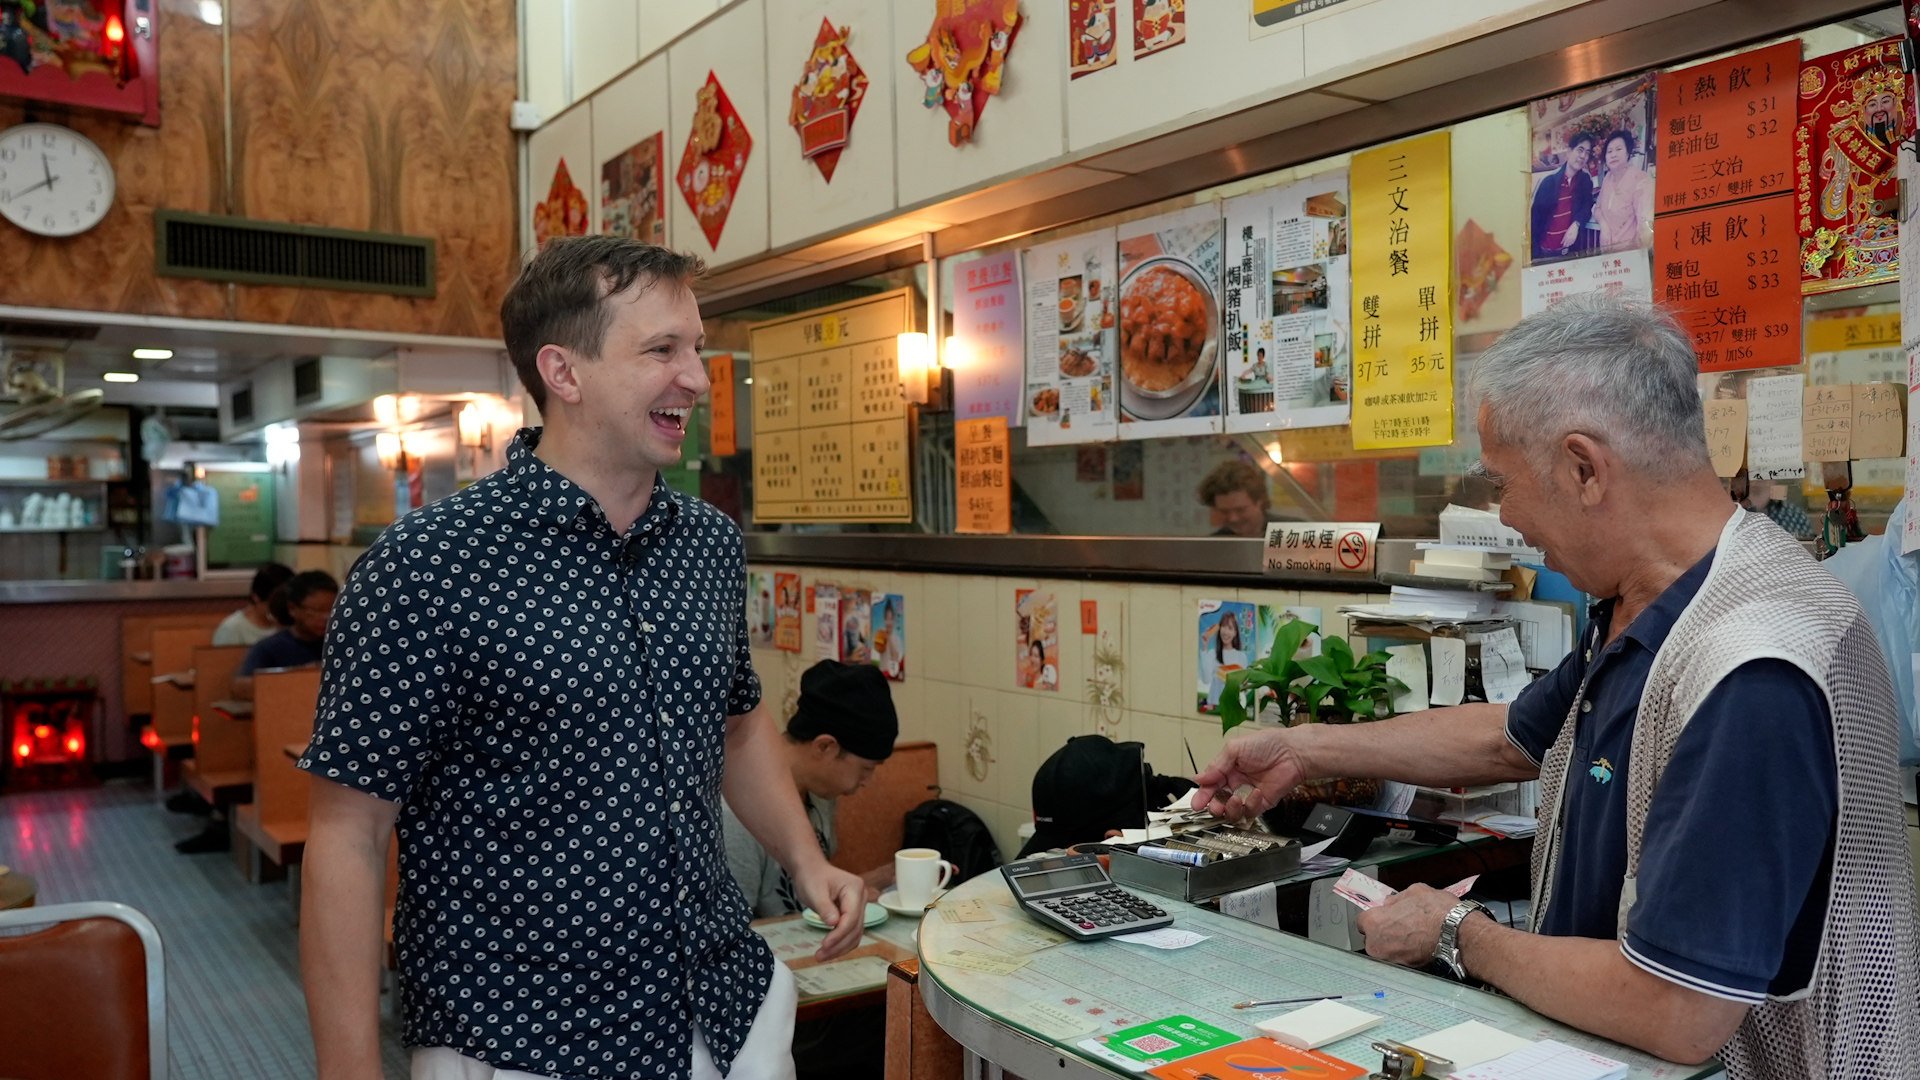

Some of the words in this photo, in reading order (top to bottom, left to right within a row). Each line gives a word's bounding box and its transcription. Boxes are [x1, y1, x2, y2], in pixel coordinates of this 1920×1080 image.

[1747, 96, 1776, 117] $31
[1747, 119, 1778, 139] $32
[21, 134, 32, 150] 11
[42, 133, 56, 150] 12
[1668, 131, 1719, 159] 鮮油包
[1691, 155, 1743, 182] 三文治
[1663, 190, 1687, 207] 單拼
[1727, 179, 1753, 196] 雙拼
[1760, 173, 1784, 189] $37
[1388, 155, 1409, 277] 三文治餐
[1241, 225, 1253, 289] 樓上雅座
[1747, 250, 1779, 267] $32
[1665, 279, 1720, 303] 鮮油包
[1747, 273, 1780, 291] $33
[1227, 266, 1241, 353] 焗豬扒飯
[1418, 285, 1439, 342] 單拼
[1692, 306, 1747, 329] 三文治
[1363, 294, 1381, 349] 雙拼
[1731, 326, 1758, 343] 雙拼
[1764, 323, 1789, 338] $39
[1268, 528, 1335, 550] 請勿吸煙
[1268, 558, 1282, 569] No
[1286, 558, 1331, 573] Smoking
